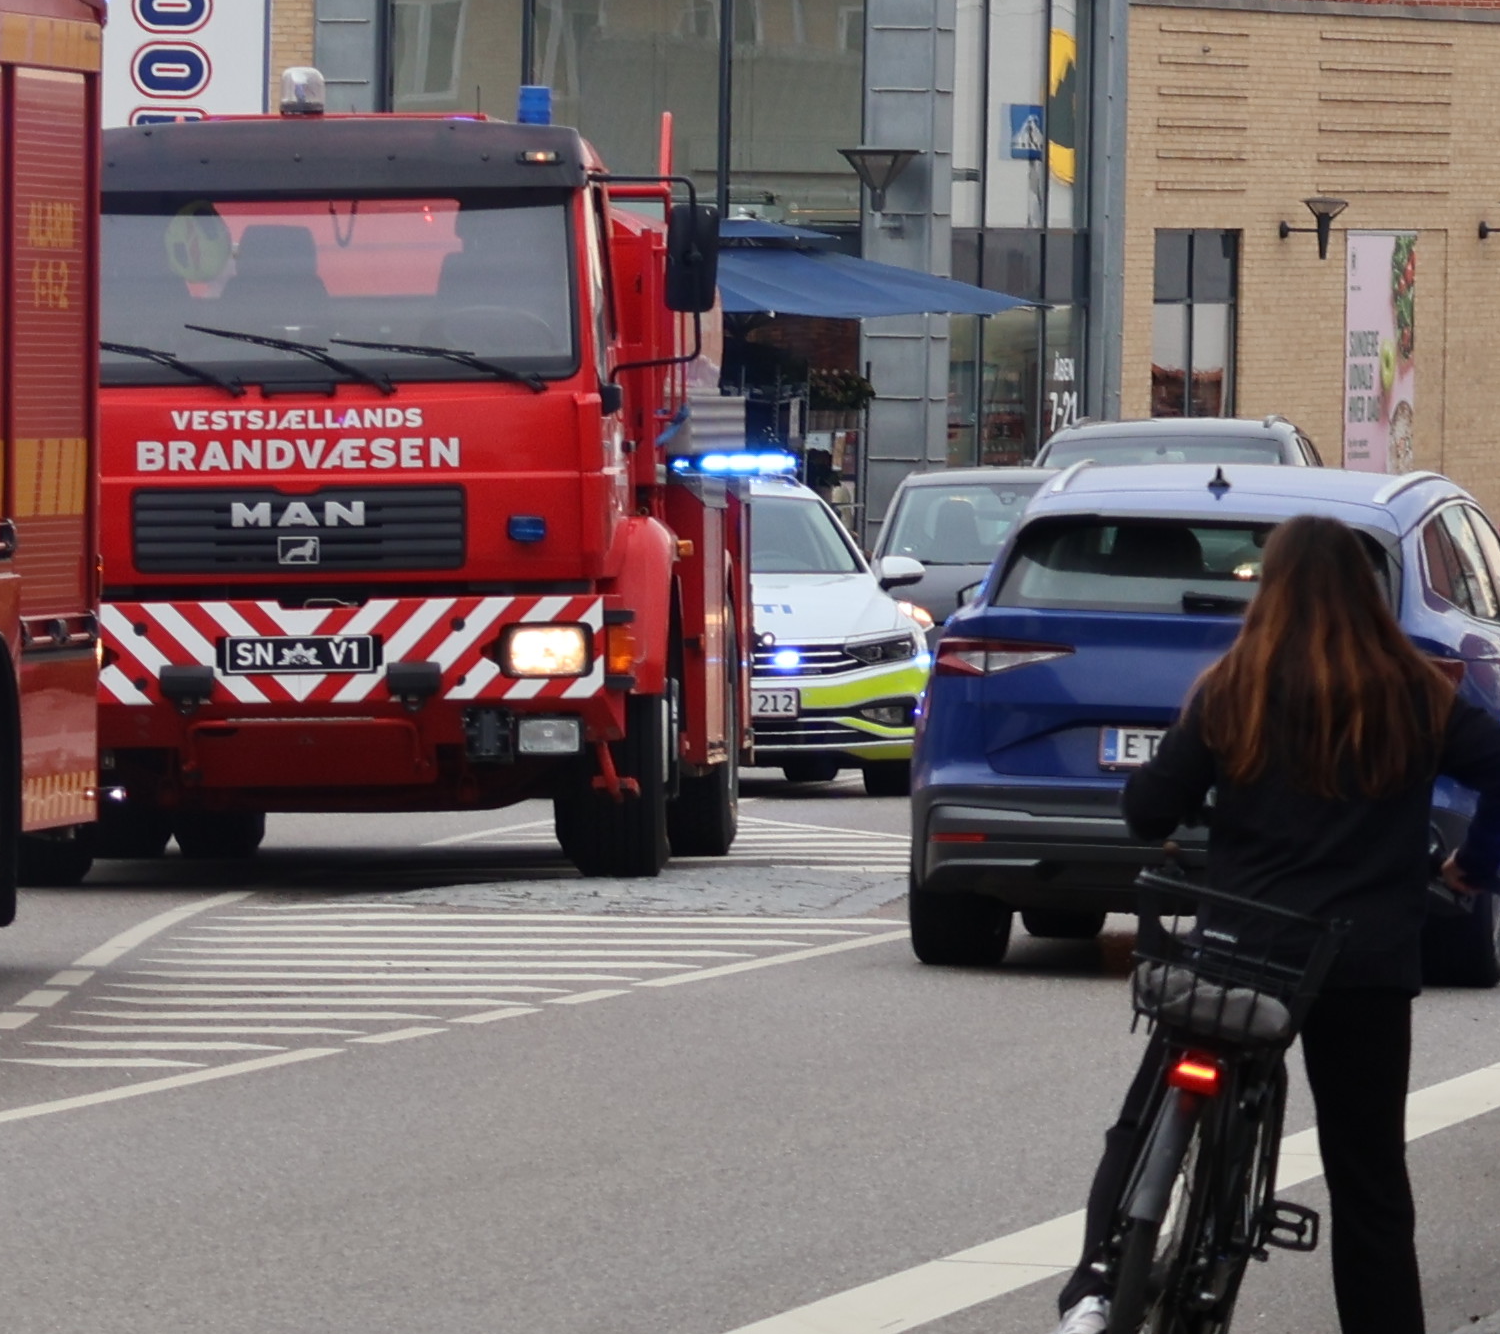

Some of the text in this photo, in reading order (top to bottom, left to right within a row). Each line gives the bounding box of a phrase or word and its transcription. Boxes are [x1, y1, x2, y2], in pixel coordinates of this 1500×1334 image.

[171, 408, 422, 430] VESTSJÆLLANDS
[136, 437, 460, 471] BRANDVÆSEN
[231, 501, 365, 527] MAN
[236, 641, 359, 666] SN V1
[758, 694, 794, 713] 212
